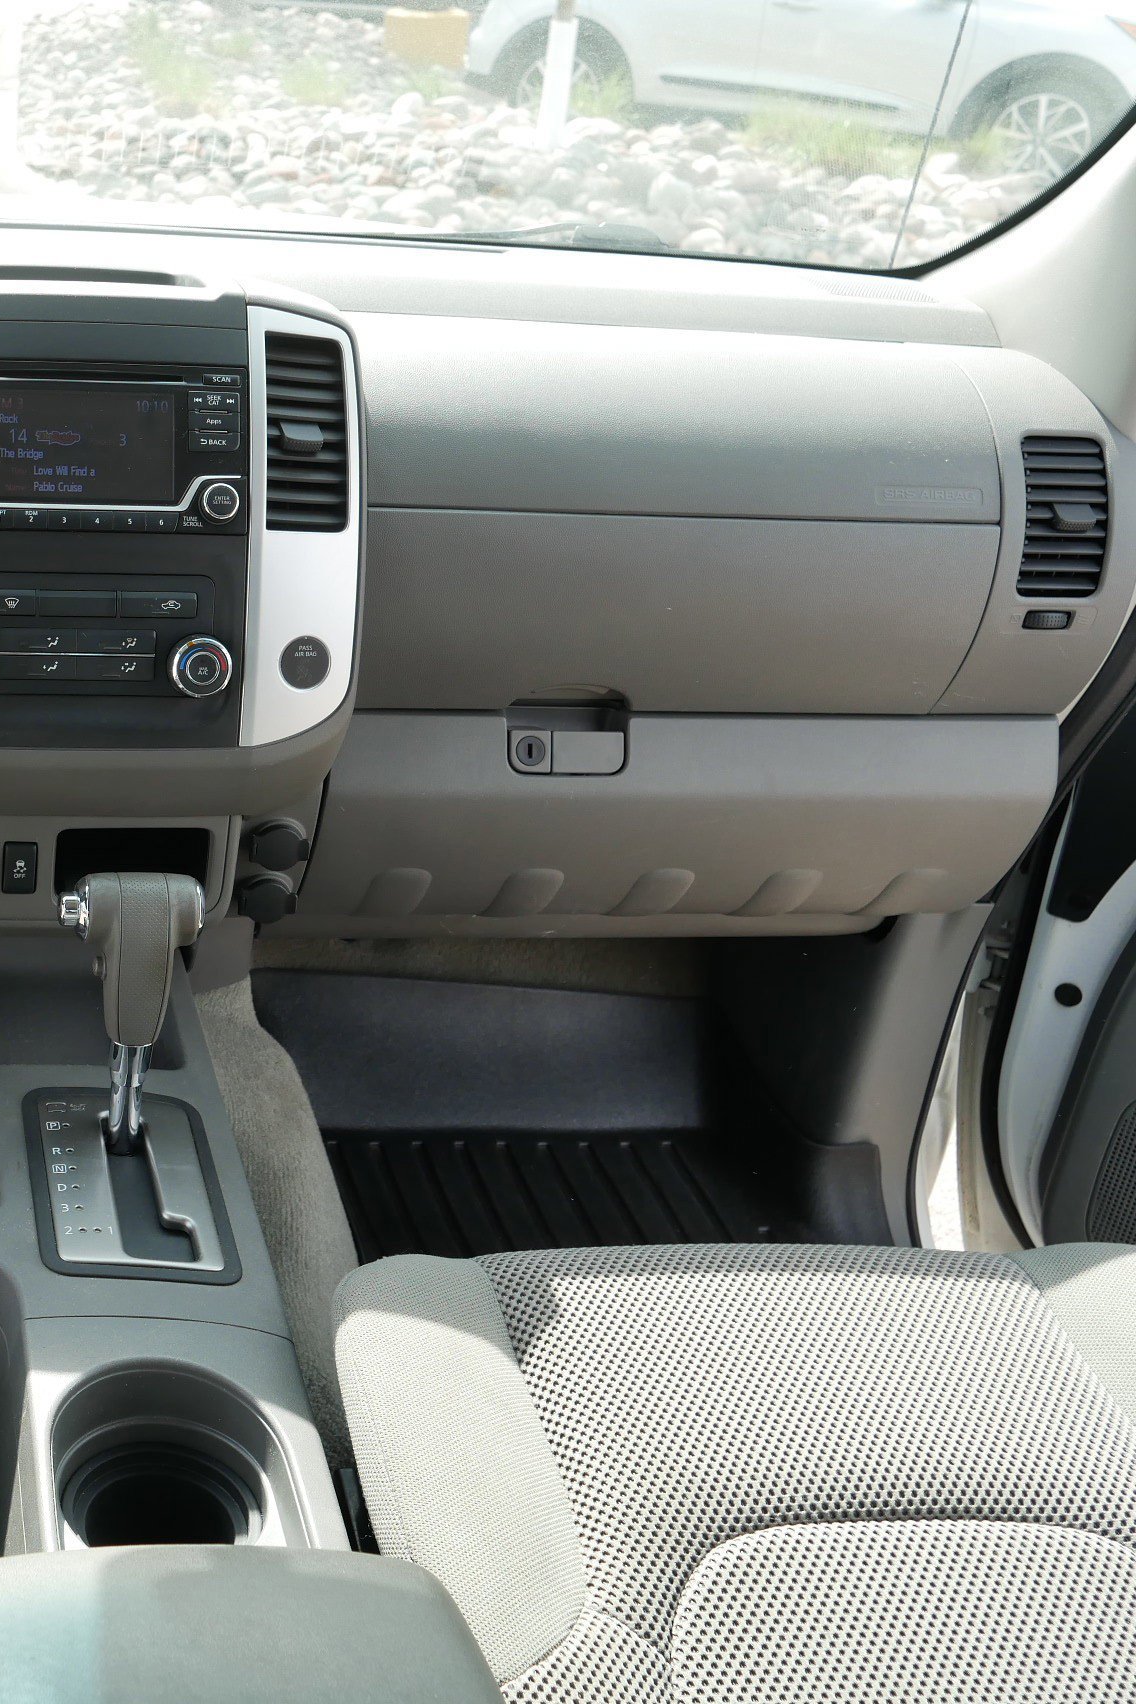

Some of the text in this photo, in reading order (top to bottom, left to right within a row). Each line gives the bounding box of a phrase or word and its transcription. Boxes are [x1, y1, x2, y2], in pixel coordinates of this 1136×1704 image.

[136, 400, 169, 413] 10:10
[0, 413, 19, 423] Rock
[9, 428, 27, 444] 14
[119, 433, 127, 447] 3
[0, 448, 44, 460] The Bridge
[33, 466, 53, 476] Love
[55, 466, 68, 476] Will
[70, 466, 87, 476] Find
[33, 482, 83, 493] Pablo Cruise
[883, 487, 976, 501] SRS AIRBAG
[62, 516, 67, 524] 3
[52, 1147, 62, 1155] R
[57, 1183, 67, 1192] D
[61, 1203, 69, 1213] 3
[64, 1225, 113, 1235] 2 1
